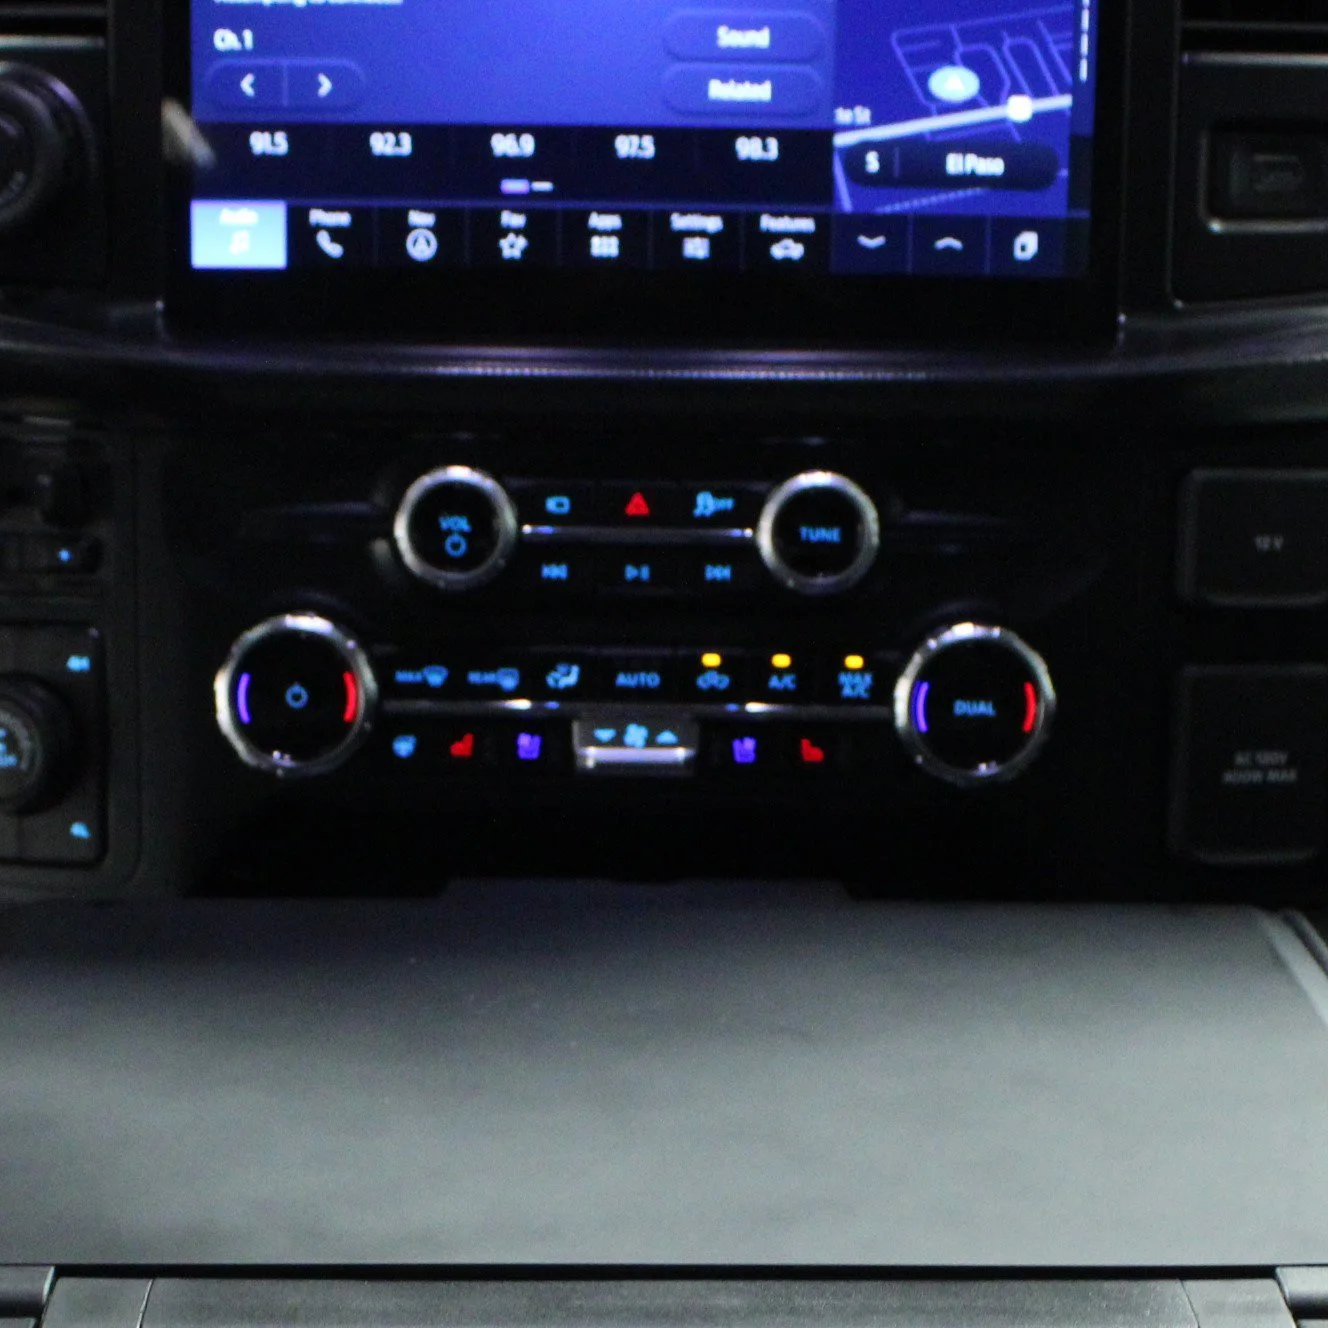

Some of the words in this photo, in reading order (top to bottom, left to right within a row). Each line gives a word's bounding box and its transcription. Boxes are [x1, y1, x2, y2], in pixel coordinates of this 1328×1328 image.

[716, 25, 771, 49] Sound
[439, 515, 472, 532] VOL
[799, 526, 841, 543] TUNE
[615, 672, 661, 688] AUTO
[953, 700, 996, 717] DUAL
